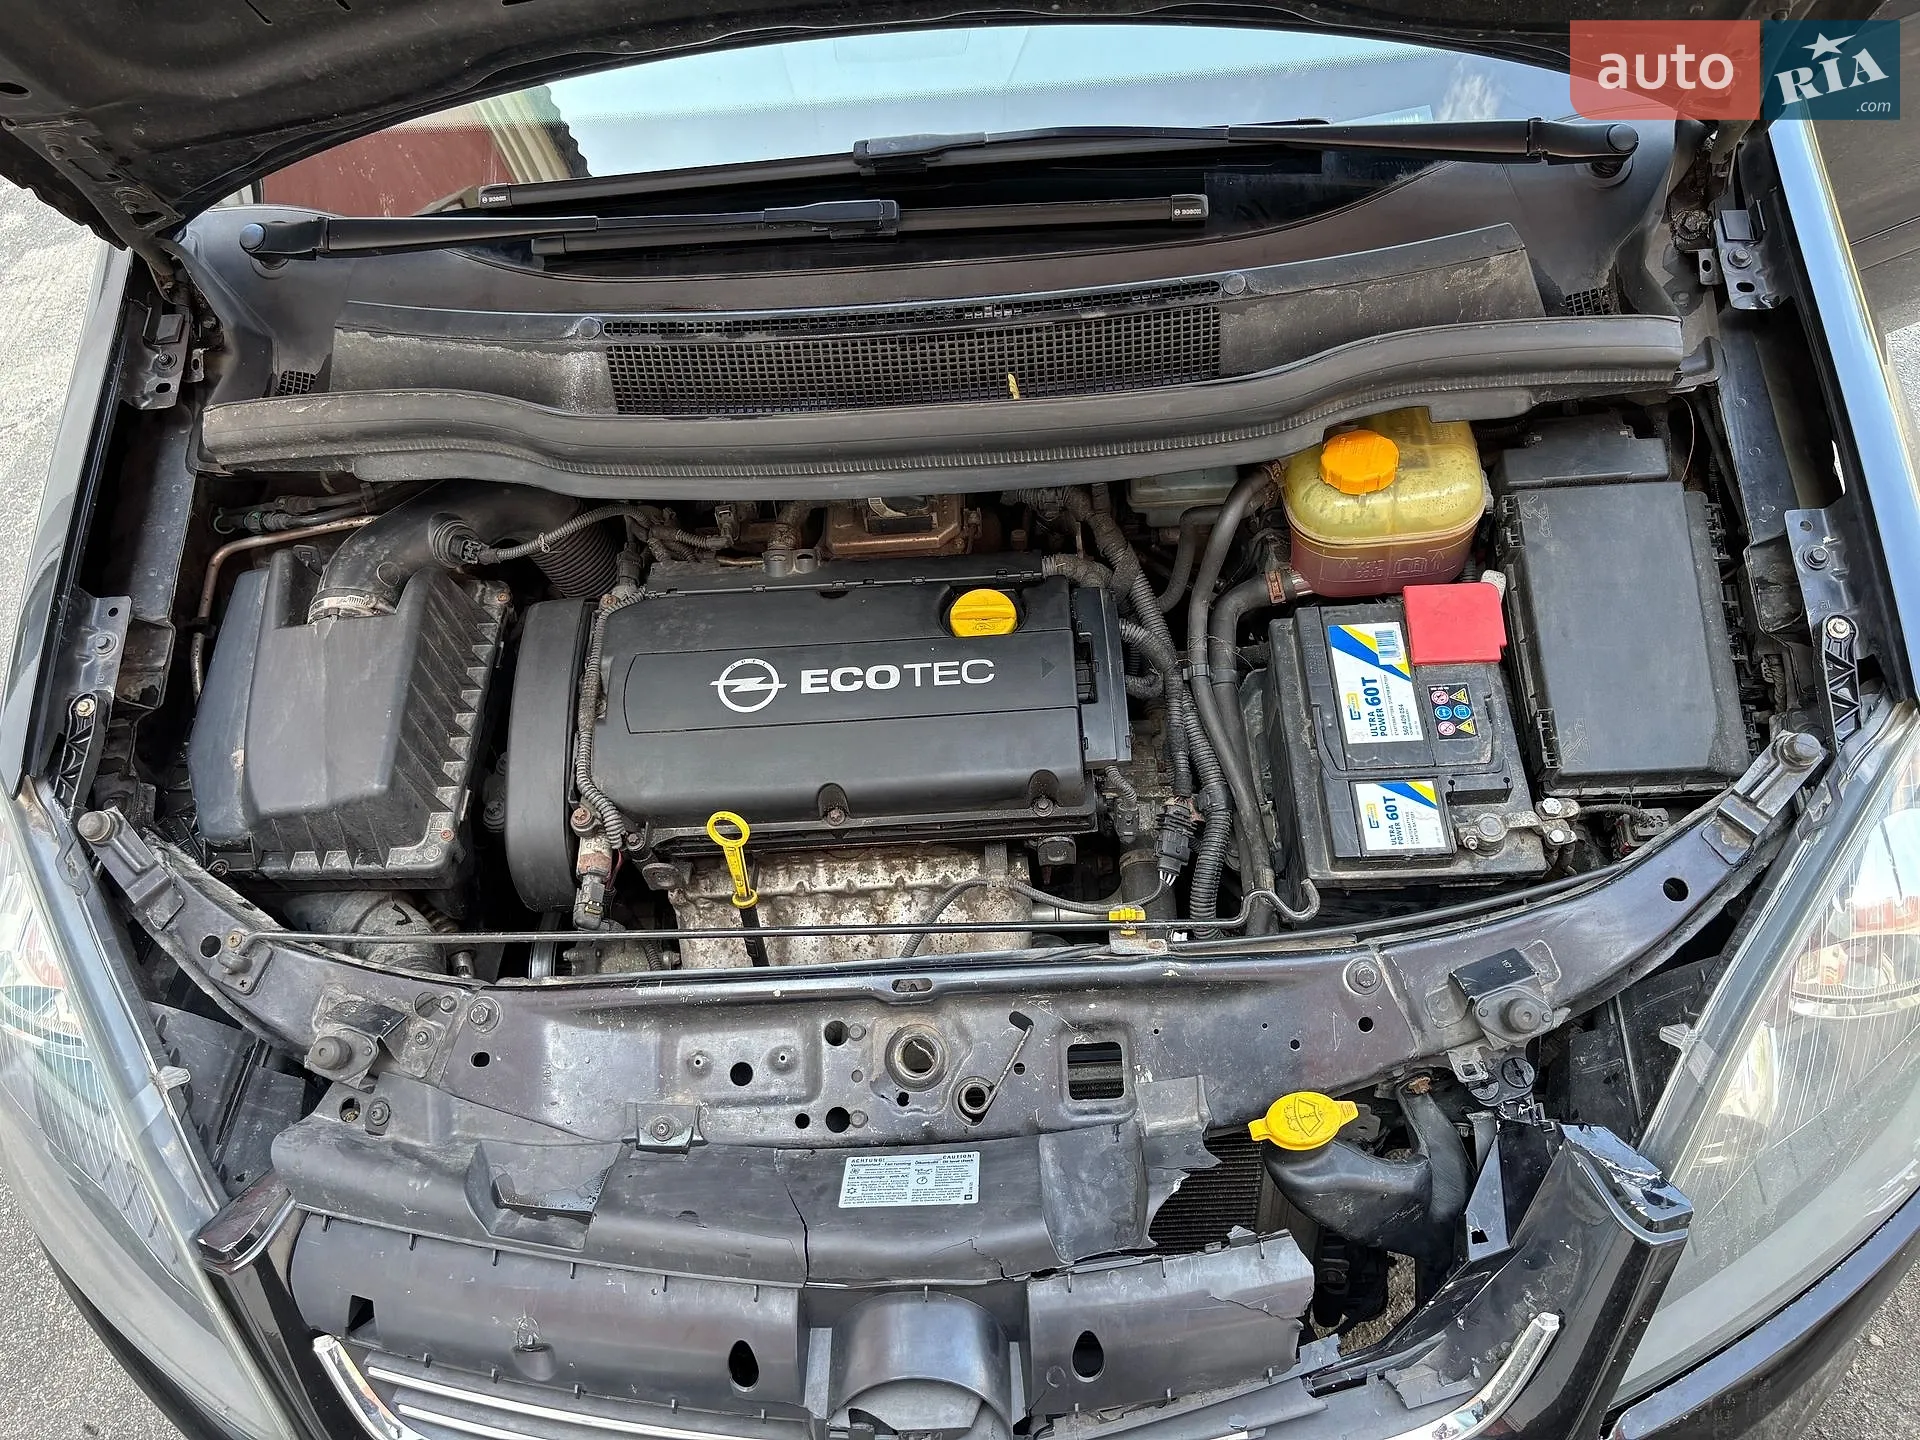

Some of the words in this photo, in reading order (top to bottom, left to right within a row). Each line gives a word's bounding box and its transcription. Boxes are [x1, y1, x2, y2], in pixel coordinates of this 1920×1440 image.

[800, 659, 996, 694] ECOTEC
[1361, 677, 1381, 706] 60T
[1367, 711, 1379, 737] ULTRA
[1376, 707, 1388, 736] POWER
[1383, 795, 1399, 821] 60T
[1388, 825, 1398, 846] ULTRA
[1395, 822, 1404, 845] POWER
